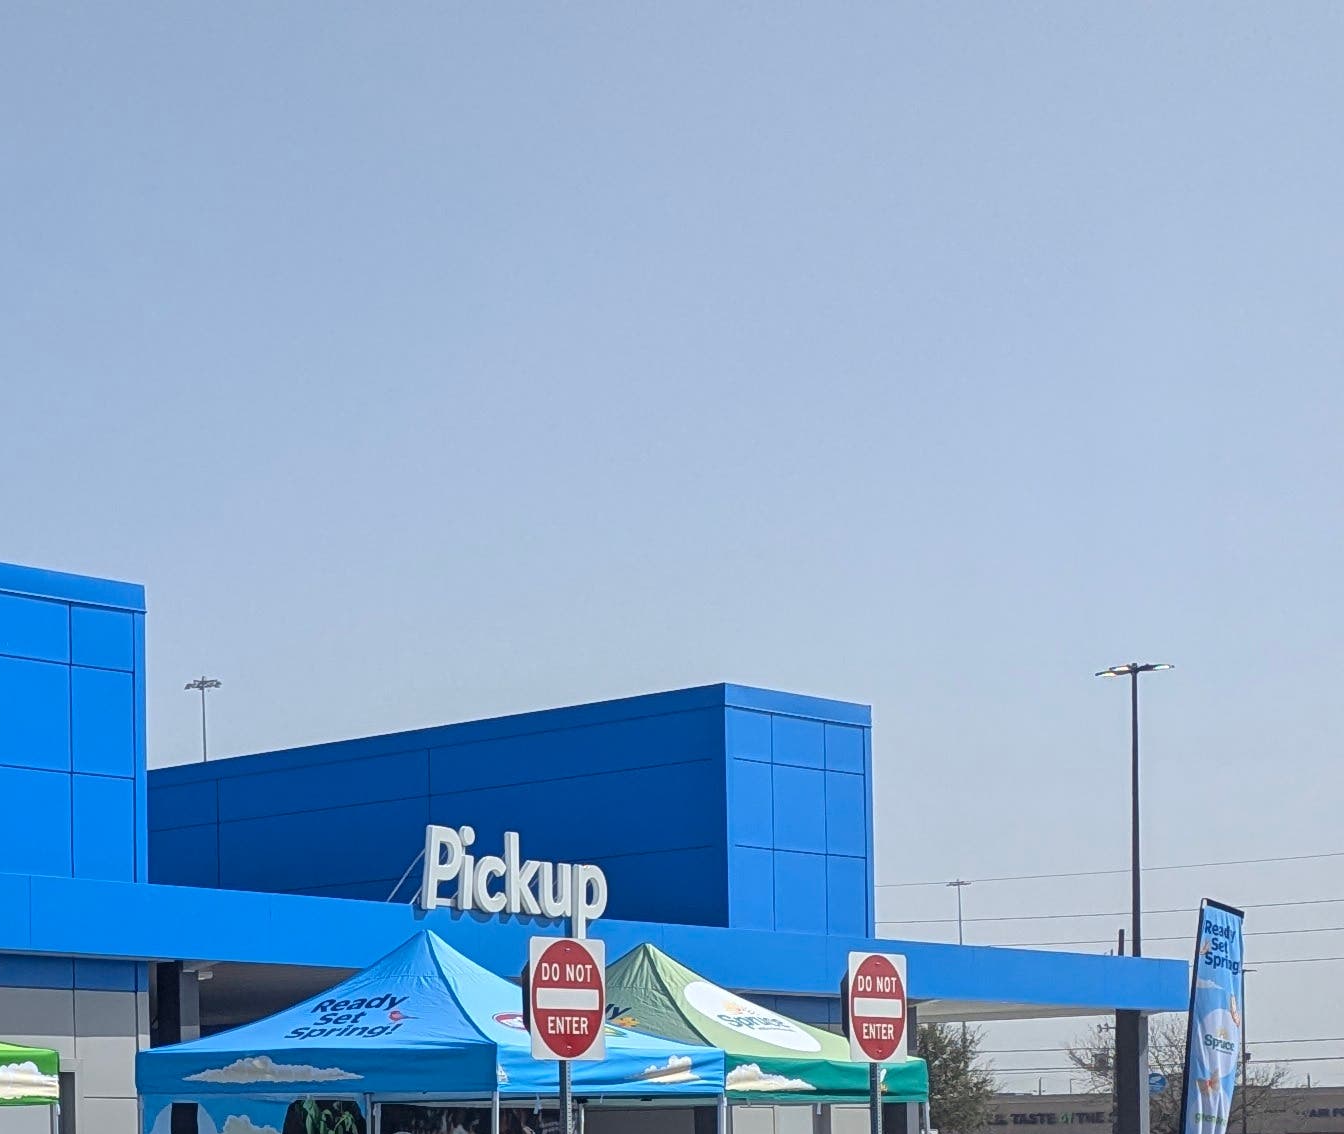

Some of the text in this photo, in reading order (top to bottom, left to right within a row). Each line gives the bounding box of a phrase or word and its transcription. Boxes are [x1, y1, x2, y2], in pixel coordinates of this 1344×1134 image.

[421, 824, 608, 939] Pickup
[1204, 920, 1236, 943] Ready
[541, 963, 593, 982] DO NOT
[856, 976, 897, 993] DO NOT
[309, 993, 410, 1014] Ready
[313, 1010, 368, 1026] Set
[547, 1016, 589, 1035] ENTER
[284, 1022, 404, 1040] Spring!
[862, 1024, 895, 1040] ENTER
